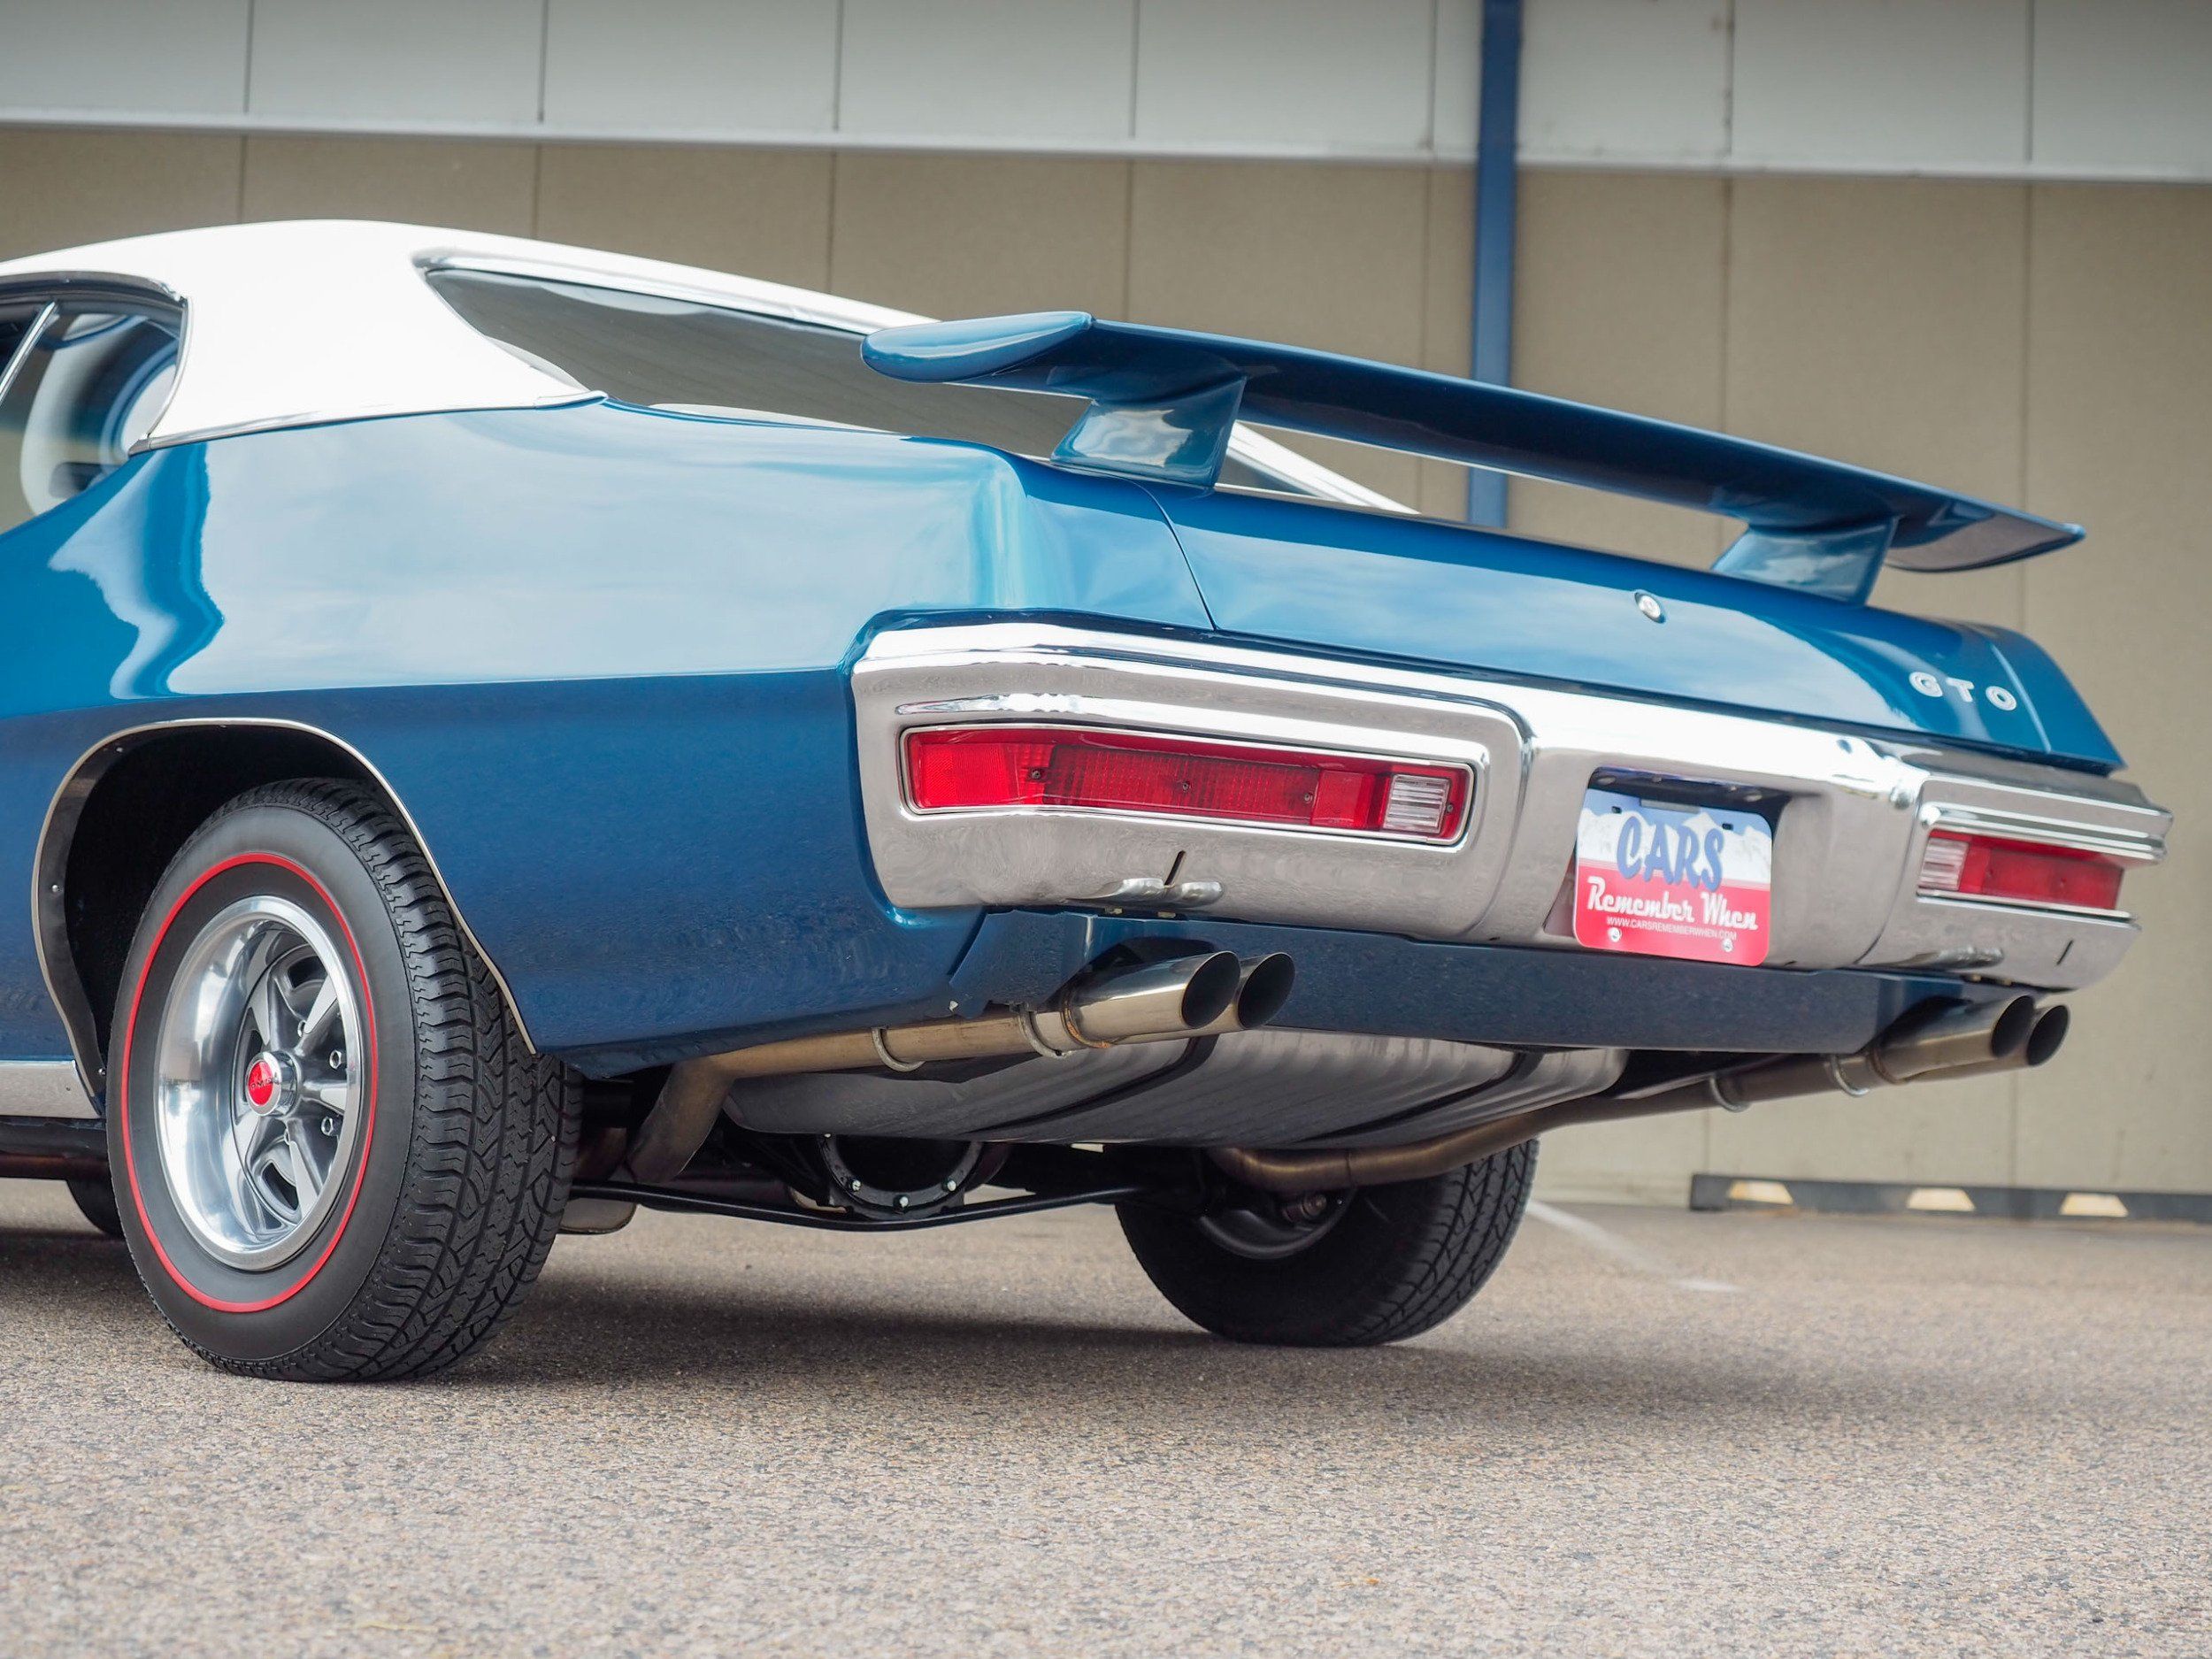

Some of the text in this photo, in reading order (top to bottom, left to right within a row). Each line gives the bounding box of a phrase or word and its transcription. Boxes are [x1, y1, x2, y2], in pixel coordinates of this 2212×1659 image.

[1909, 671, 2017, 711] GTO
[1617, 816, 1724, 892] CARS
[1587, 876, 1758, 930] Remember When
[1606, 916, 1737, 941] WWW.CARSREMEMBERWHEN.COM
